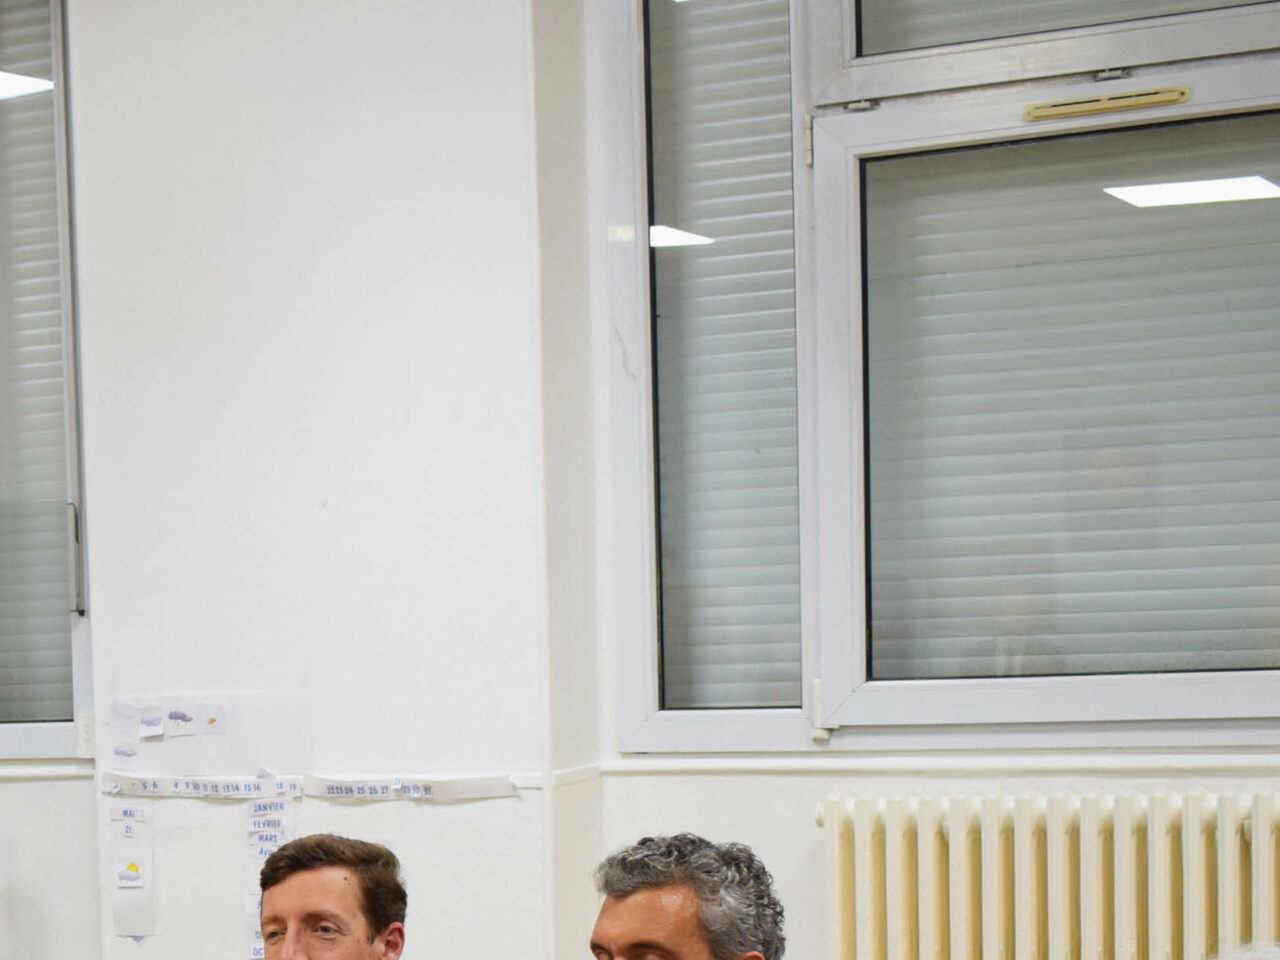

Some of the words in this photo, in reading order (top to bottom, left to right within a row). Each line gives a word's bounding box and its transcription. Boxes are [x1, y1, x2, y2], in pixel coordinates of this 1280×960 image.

[210, 783, 219, 793] 12
[222, 784, 230, 793] 13
[231, 783, 240, 792] 14
[244, 782, 251, 792] 15
[253, 782, 261, 792] 16
[275, 781, 284, 790] 18
[288, 783, 297, 792] 19
[253, 802, 284, 812] JANVIER
[122, 809, 135, 818] MAI
[258, 833, 277, 843] MARS
